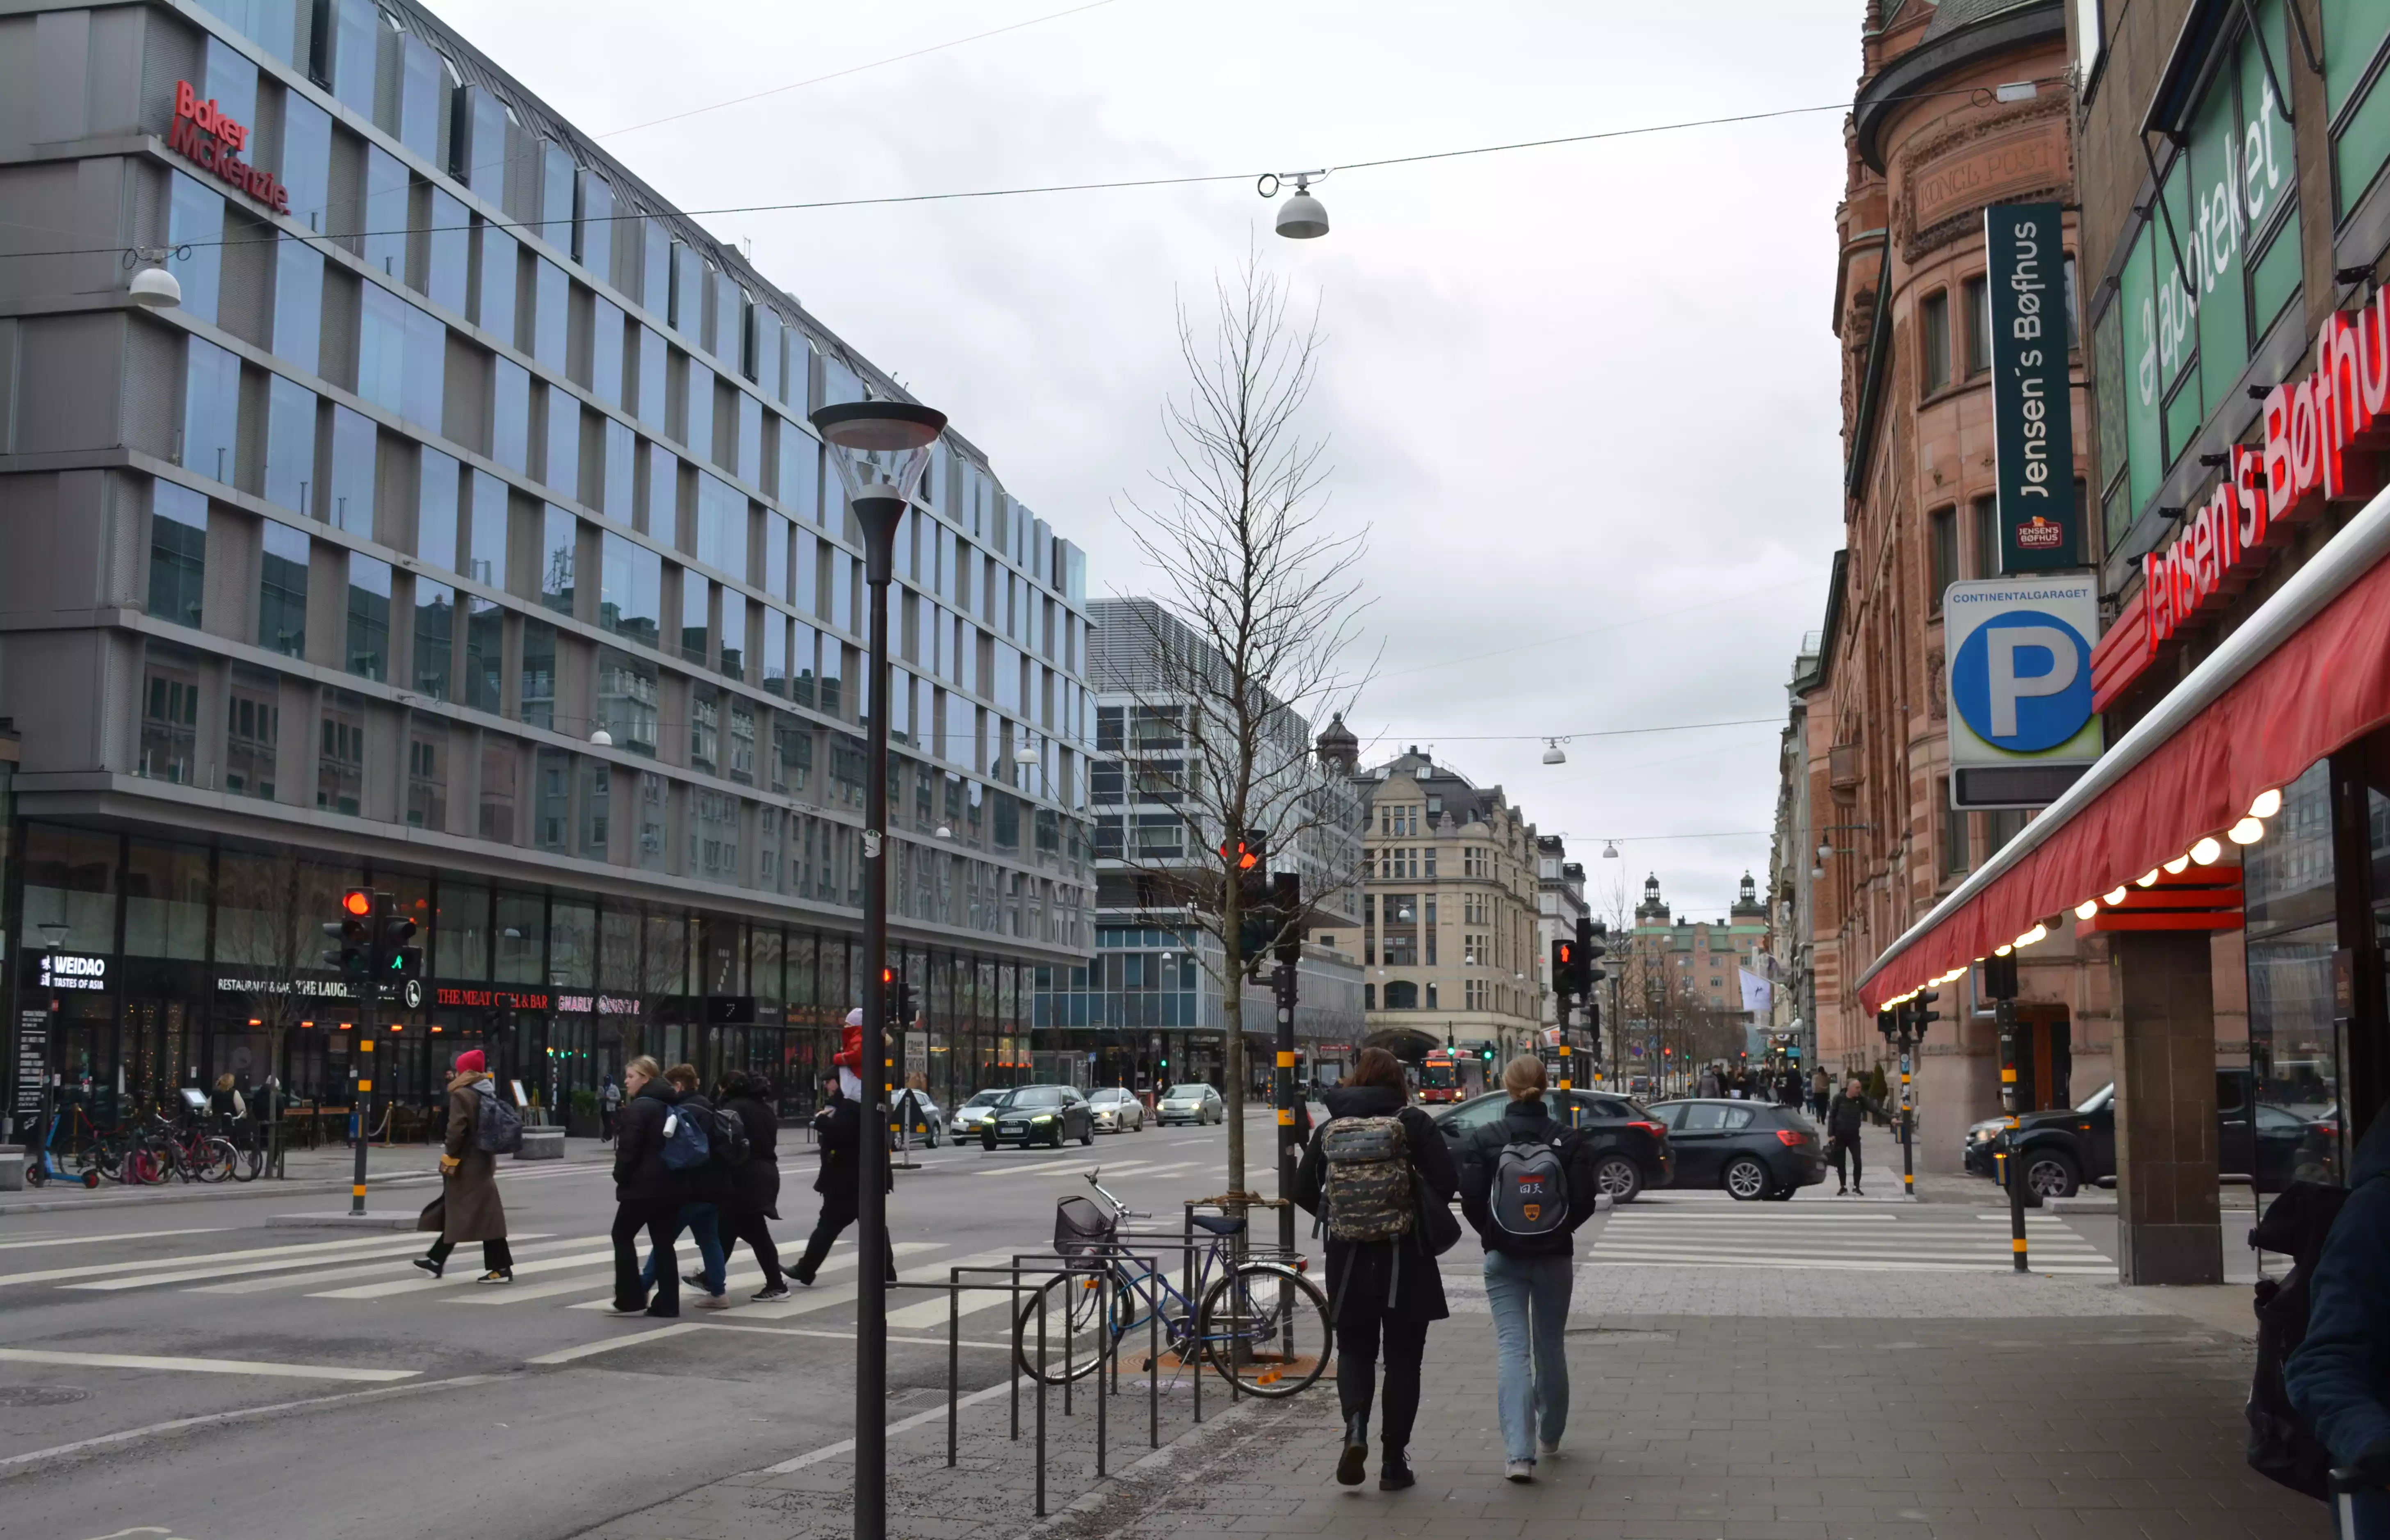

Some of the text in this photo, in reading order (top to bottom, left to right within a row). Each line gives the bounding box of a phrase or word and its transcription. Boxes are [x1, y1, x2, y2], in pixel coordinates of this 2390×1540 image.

[176, 80, 249, 151] Baker
[2160, 76, 2278, 373] apoteket
[2011, 222, 2046, 340] Bøfhus
[2019, 526, 2059, 535] JENSEN'S
[2143, 444, 2265, 644] Jensen's
[1953, 589, 2088, 603] CONTINENTALGARAGET
[1987, 626, 2078, 737] P
[55, 956, 105, 976] WEIDAO
[53, 977, 104, 990] TASTES OF ASIA
[295, 980, 317, 995] THE
[437, 989, 460, 1004] THE
[462, 990, 491, 1006] MEAT
[530, 995, 548, 1009] BAR
[558, 996, 593, 1012] GNARLY
